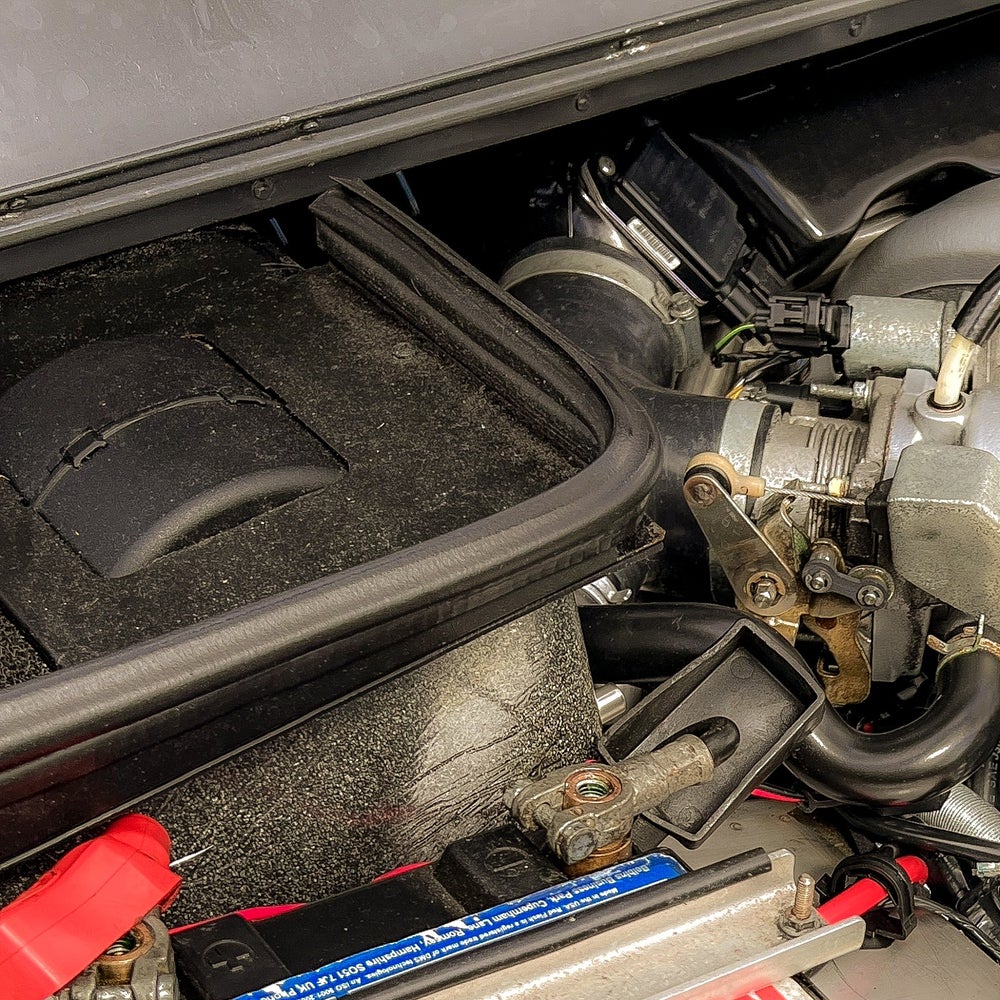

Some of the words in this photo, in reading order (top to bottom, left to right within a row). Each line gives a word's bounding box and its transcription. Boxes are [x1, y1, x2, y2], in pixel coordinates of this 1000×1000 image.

[598, 885, 618, 898] Made
[579, 894, 592, 905] the
[527, 910, 548, 923] Flash
[546, 905, 562, 916] Red
[477, 921, 514, 940] registered
[458, 934, 479, 947] trade
[439, 941, 460, 954] mark
[363, 940, 419, 969] Hampshire
[412, 951, 432, 964] DMS
[335, 961, 365, 979] SO51
[294, 978, 315, 994] UK
[334, 980, 350, 992] ISO
[349, 976, 362, 987] An
